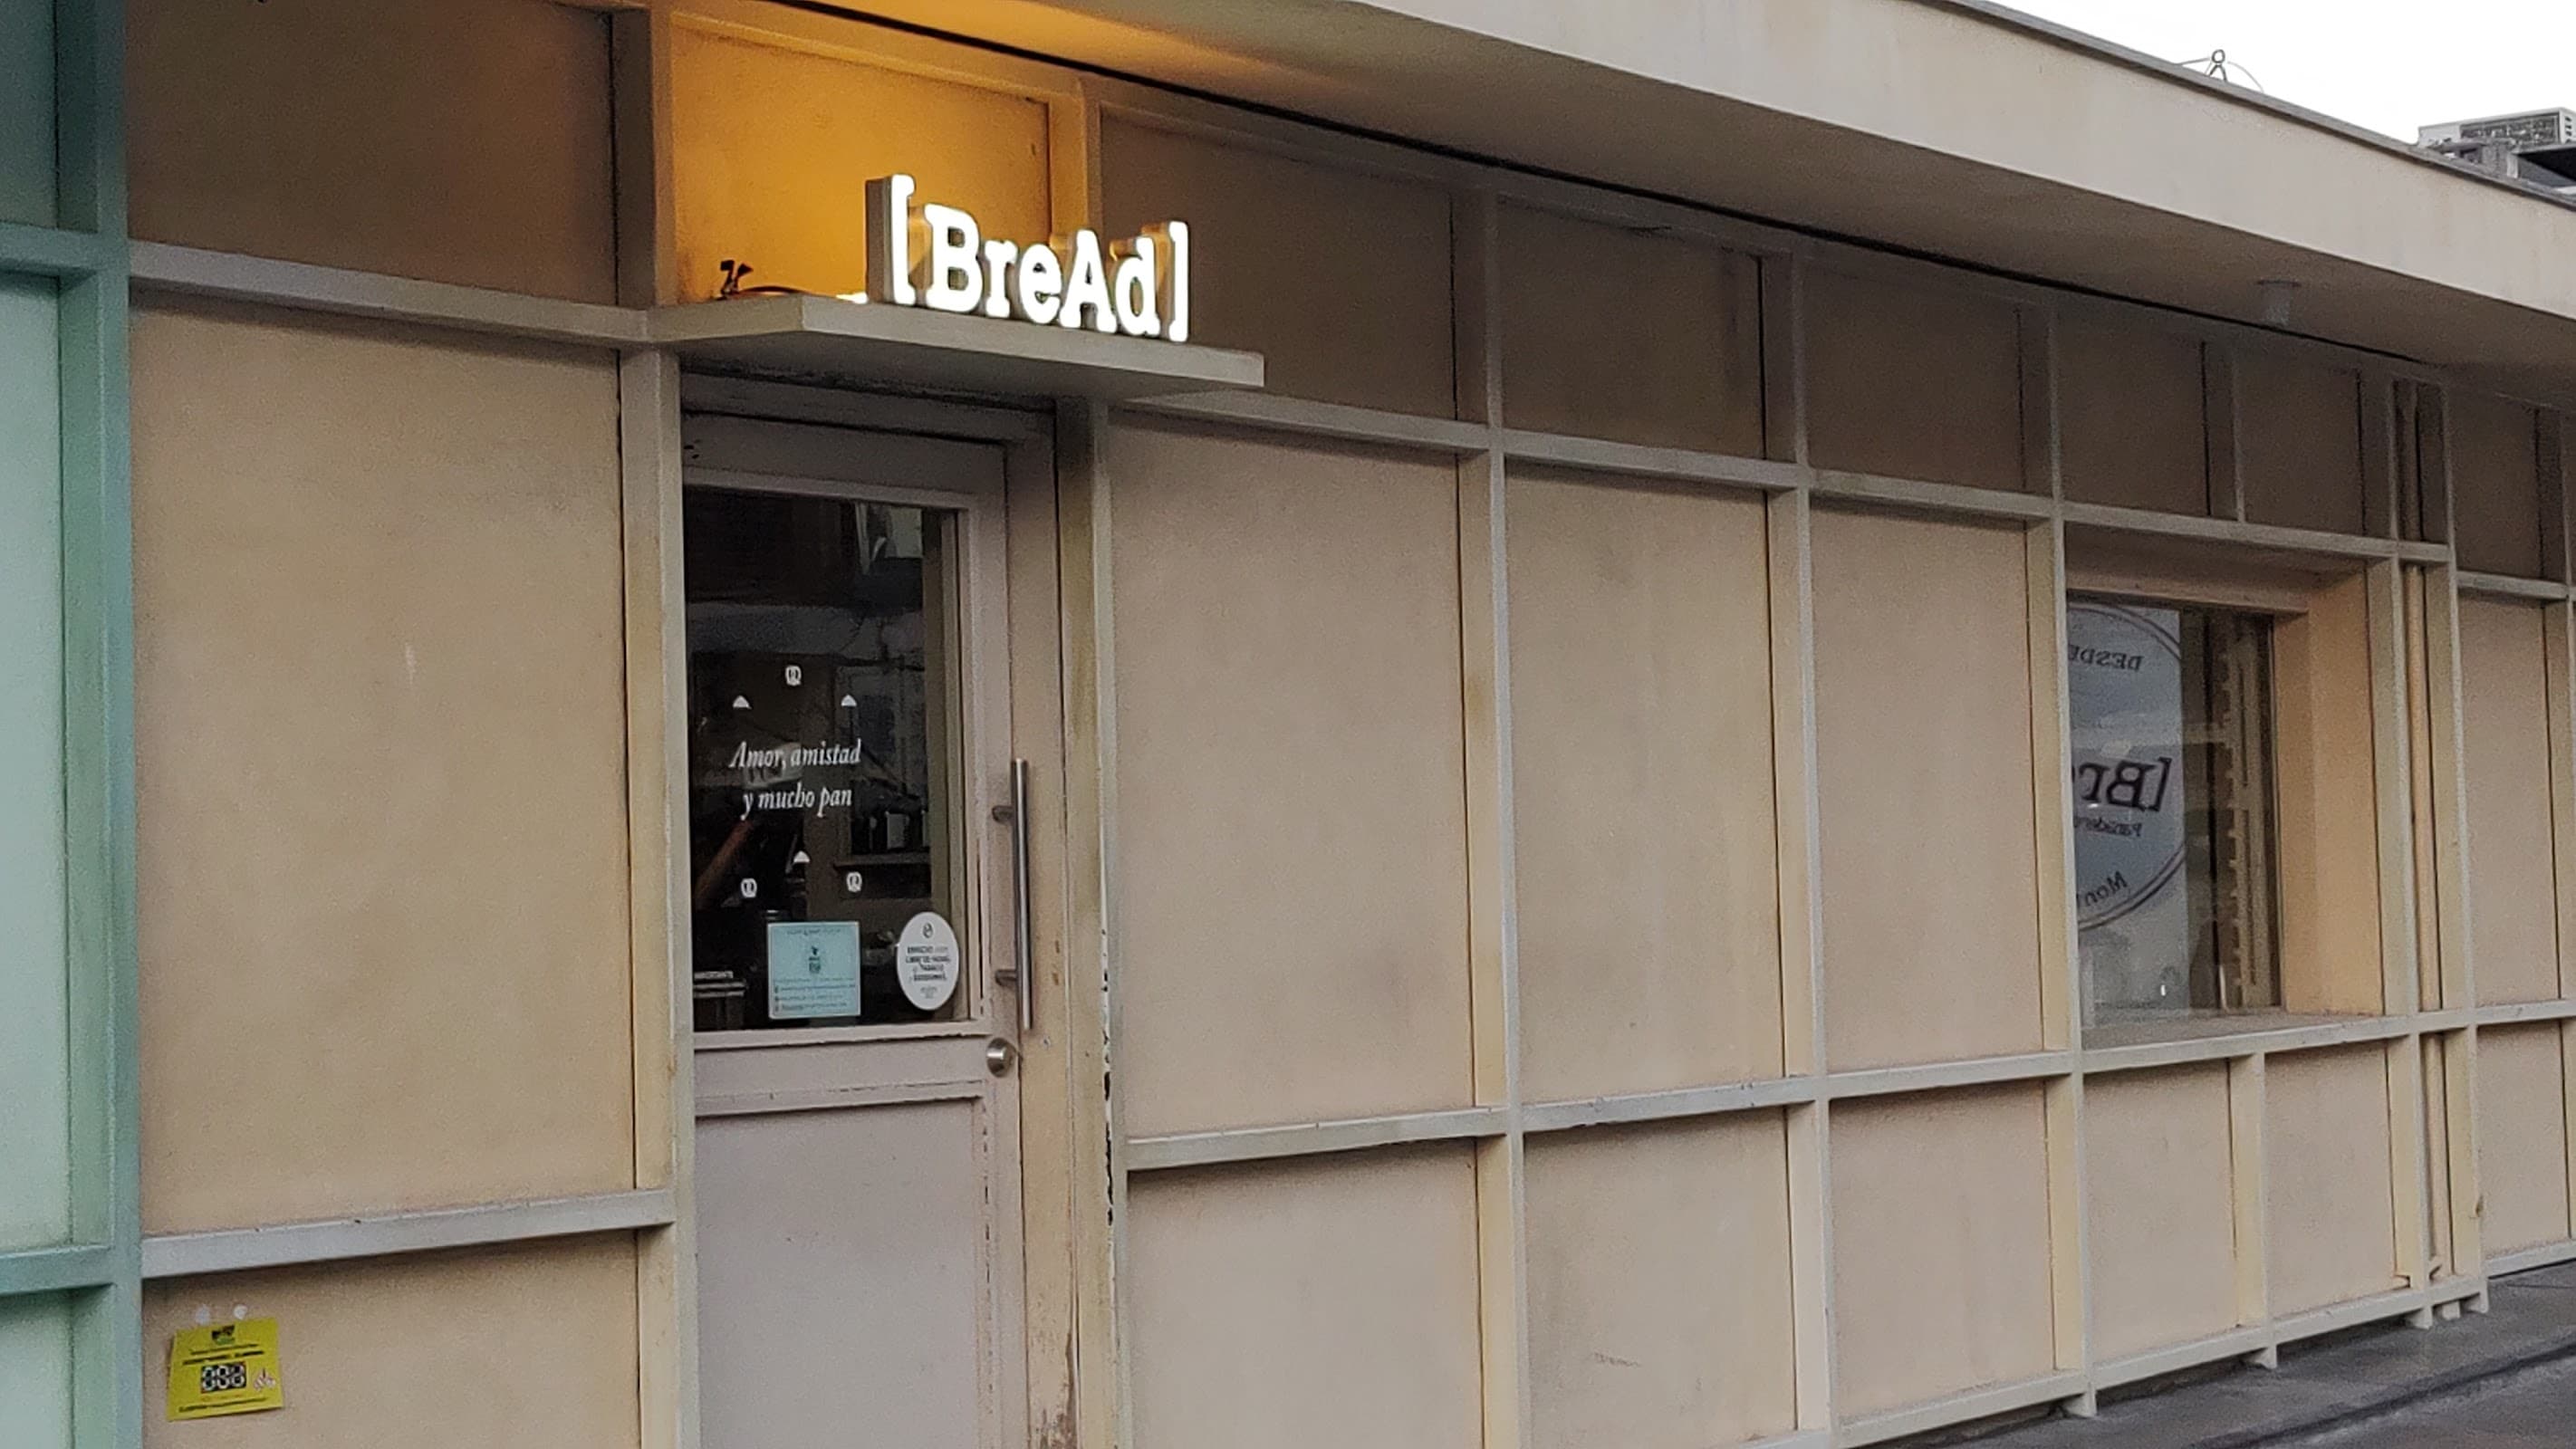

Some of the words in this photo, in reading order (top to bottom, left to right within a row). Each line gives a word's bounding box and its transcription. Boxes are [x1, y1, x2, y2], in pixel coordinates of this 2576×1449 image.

[889, 174, 1189, 342] [BreAd]
[728, 741, 786, 770] Amor,
[790, 738, 861, 766] amistad
[740, 792, 754, 820] y
[757, 782, 815, 810] mucho
[817, 785, 852, 818] pan
